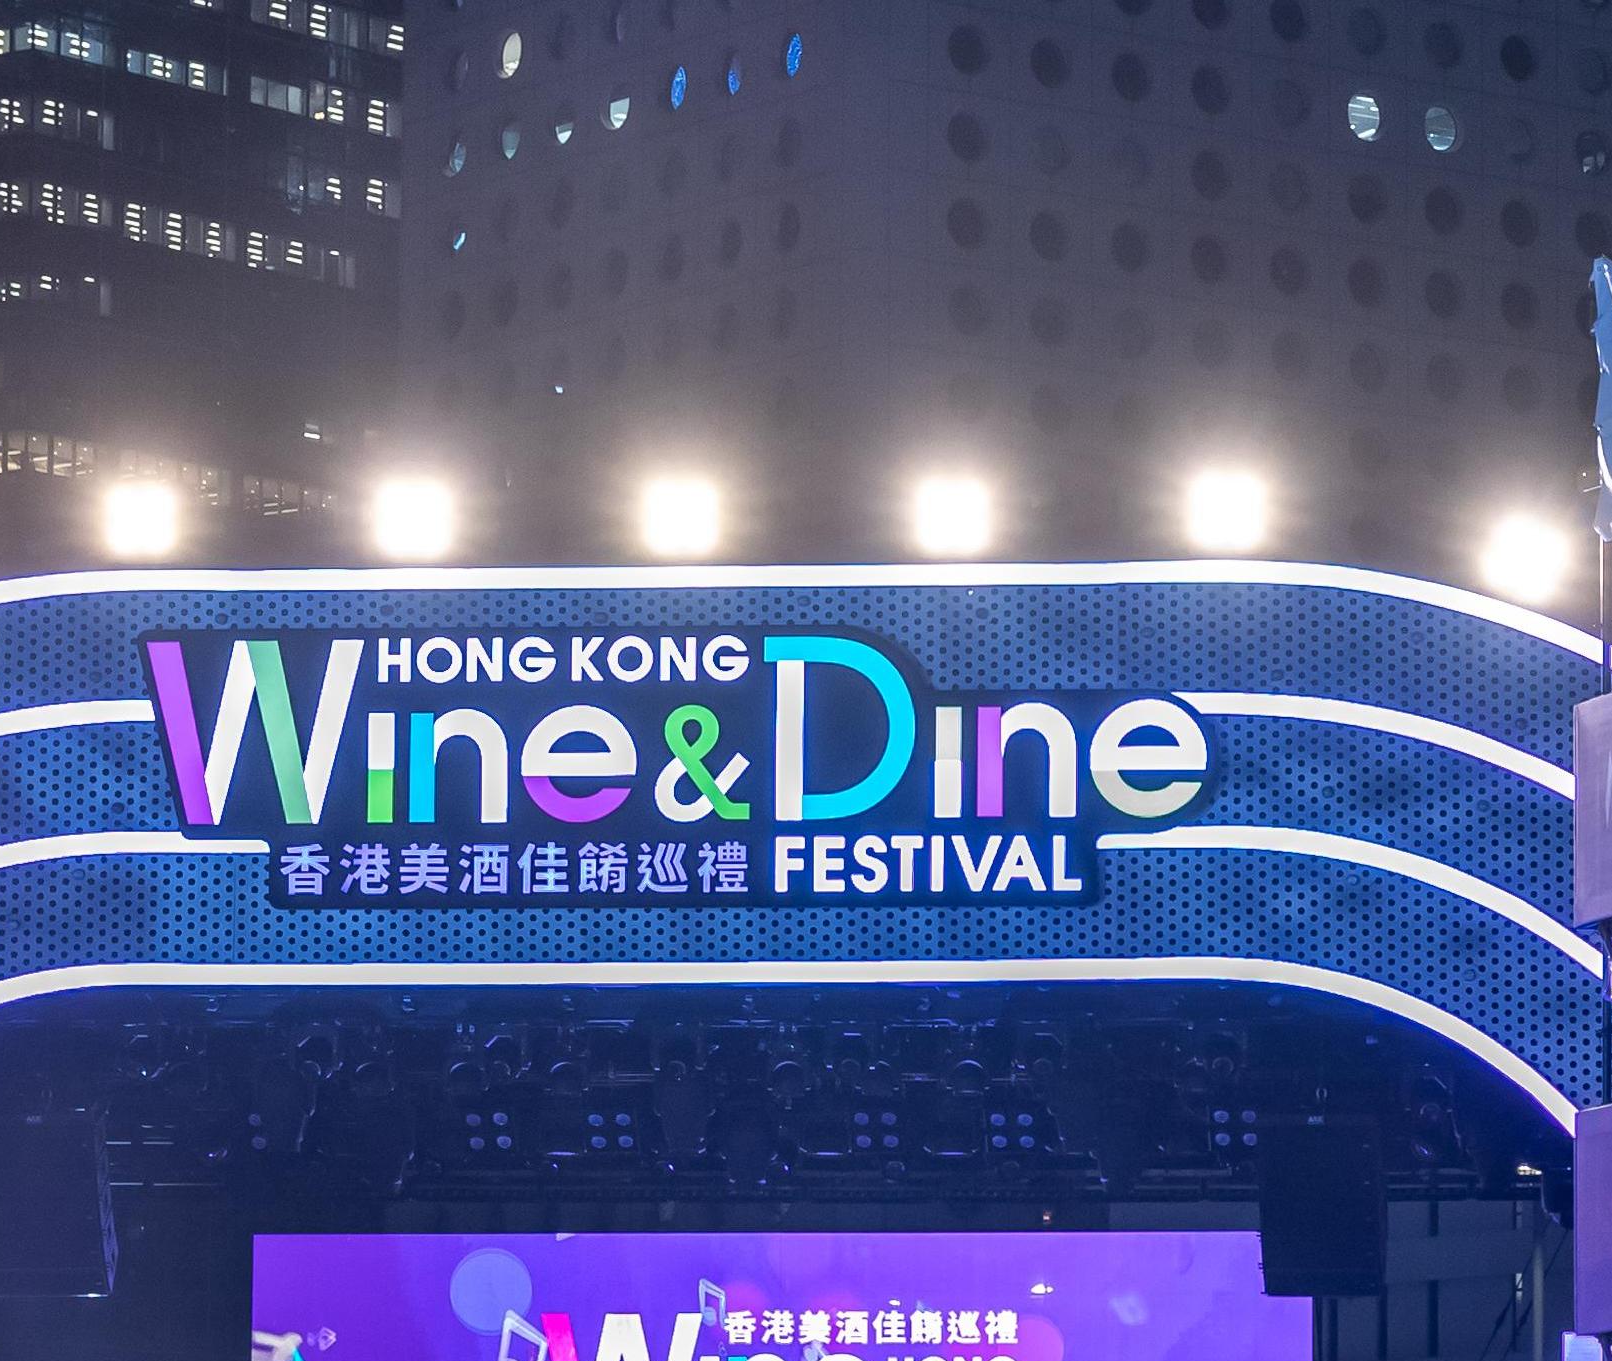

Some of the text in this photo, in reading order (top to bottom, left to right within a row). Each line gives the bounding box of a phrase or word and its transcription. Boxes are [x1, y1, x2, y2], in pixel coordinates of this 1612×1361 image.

[377, 636, 749, 683] HONG KONG
[144, 636, 1208, 826] Wine & Dine
[279, 842, 749, 897] 香港美酒佳餚巡禮
[774, 835, 1082, 893] FESTIVAL
[725, 1310, 1019, 1345] 香港美酒佳餚巡禮
